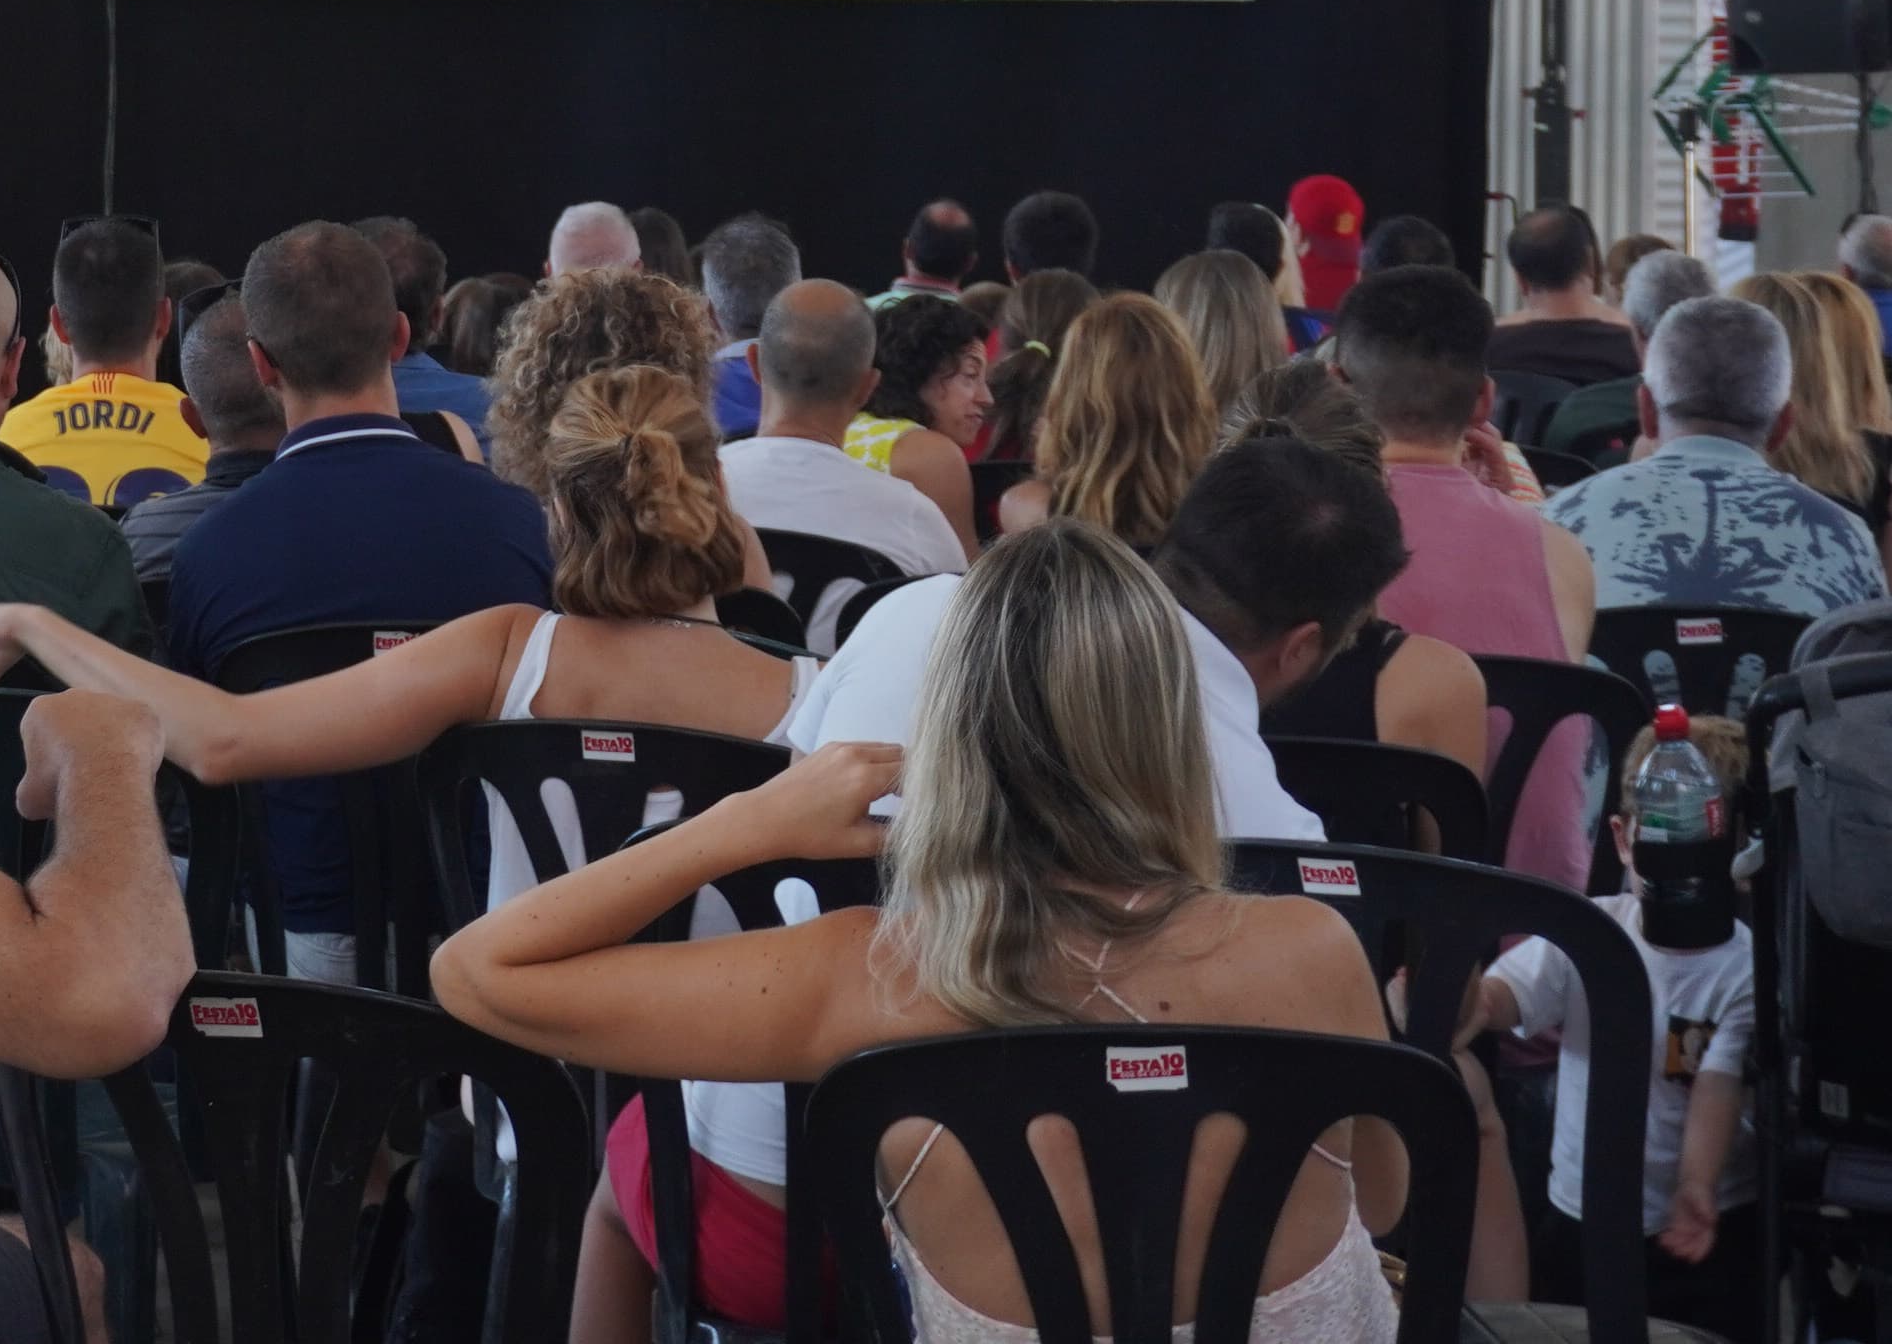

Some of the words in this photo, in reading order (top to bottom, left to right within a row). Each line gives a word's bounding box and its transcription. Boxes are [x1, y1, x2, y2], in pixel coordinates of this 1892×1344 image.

[53, 399, 156, 435] JORDI
[583, 736, 632, 749] FESTA10
[1301, 865, 1355, 880] FESTA10
[192, 1004, 258, 1019] FESTA10
[1110, 1053, 1184, 1073] FESTA10
